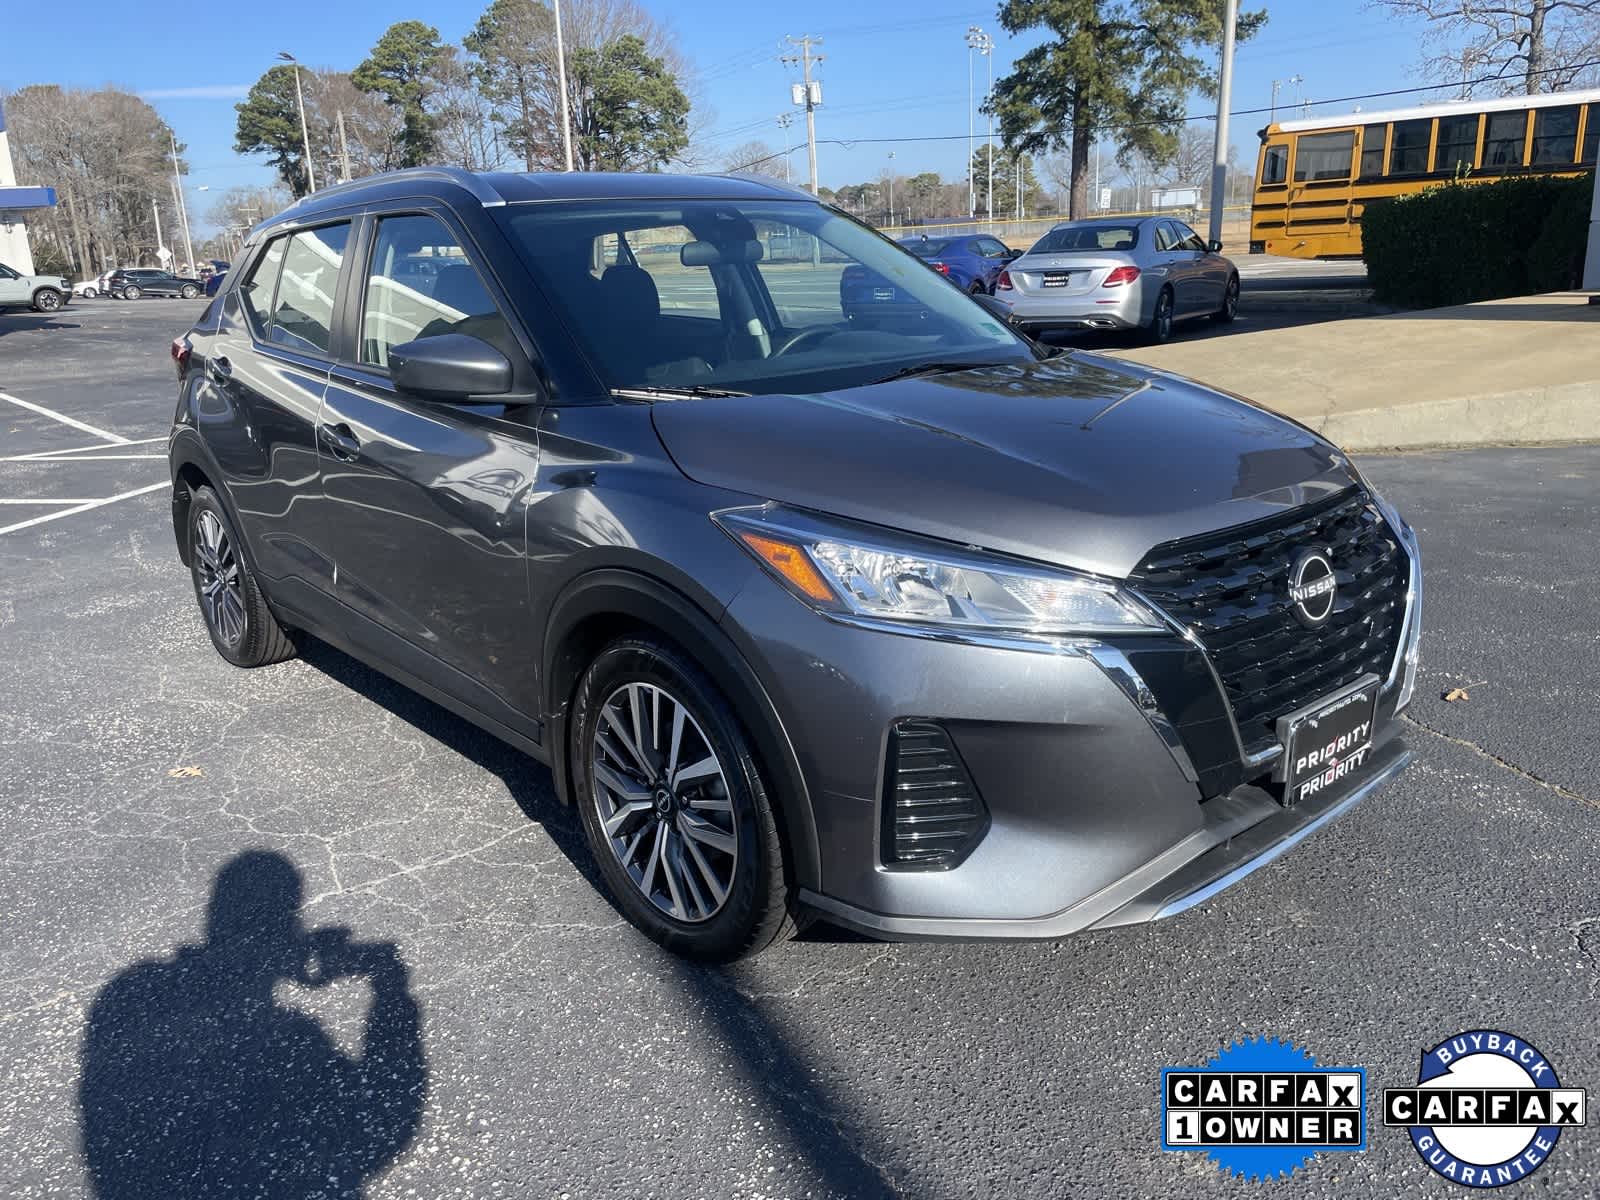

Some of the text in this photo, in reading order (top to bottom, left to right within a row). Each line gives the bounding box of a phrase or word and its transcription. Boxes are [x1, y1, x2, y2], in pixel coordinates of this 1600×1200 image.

[1293, 575, 1336, 601] NISSAN
[1296, 720, 1370, 774] PRIORITY
[1300, 749, 1365, 800] PRIORITY
